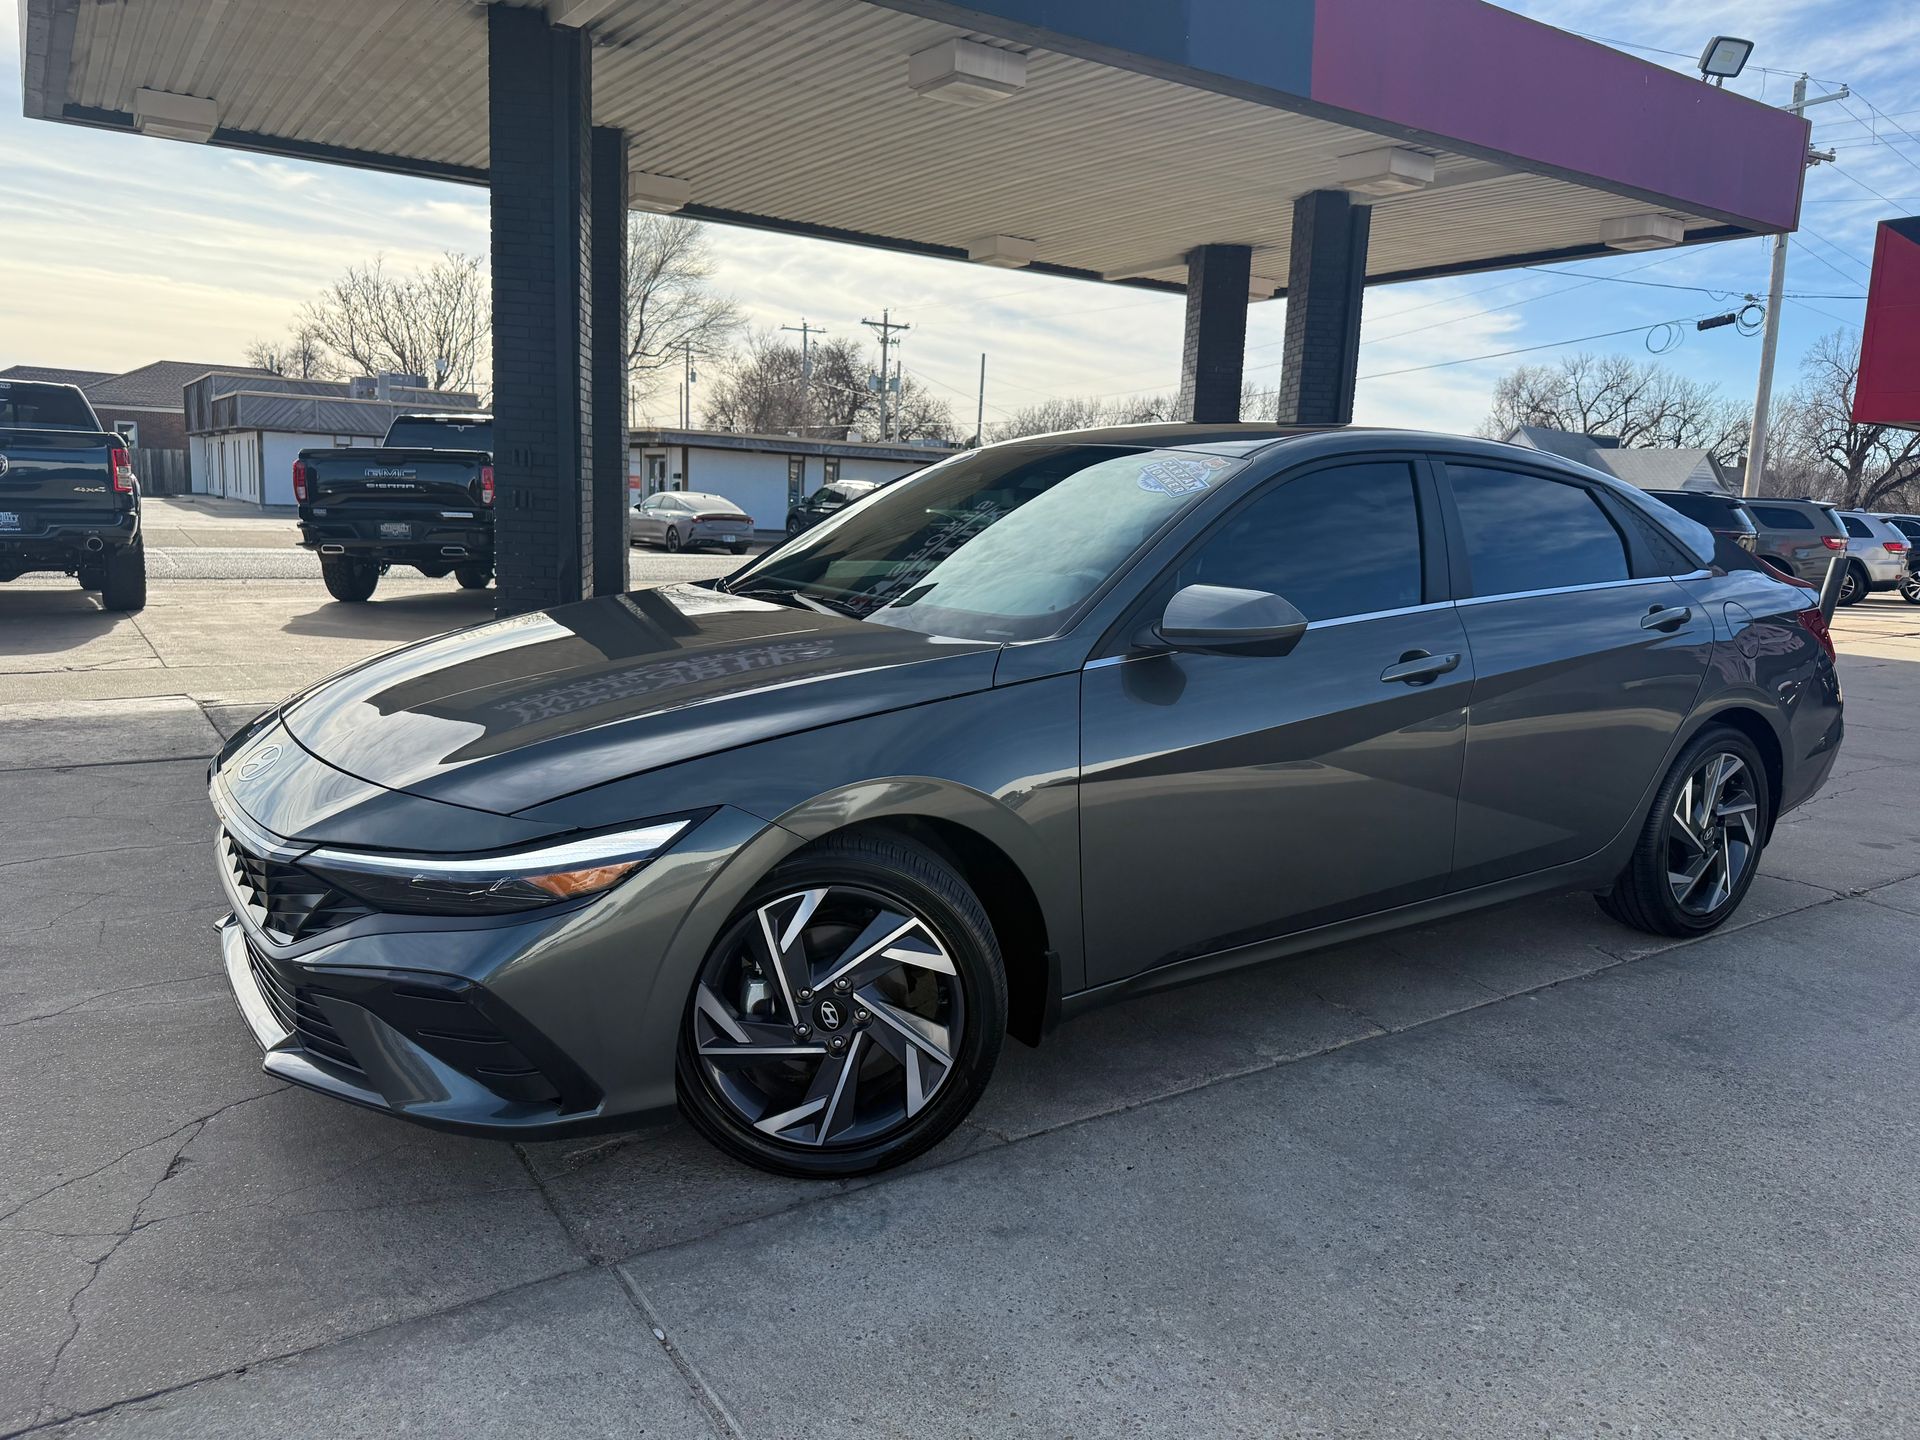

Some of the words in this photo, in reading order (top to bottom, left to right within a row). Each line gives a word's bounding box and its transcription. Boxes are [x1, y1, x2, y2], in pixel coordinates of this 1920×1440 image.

[364, 468, 416, 480] GMC
[1151, 468, 1186, 493] OWNER
[1161, 460, 1198, 491] CARFAX
